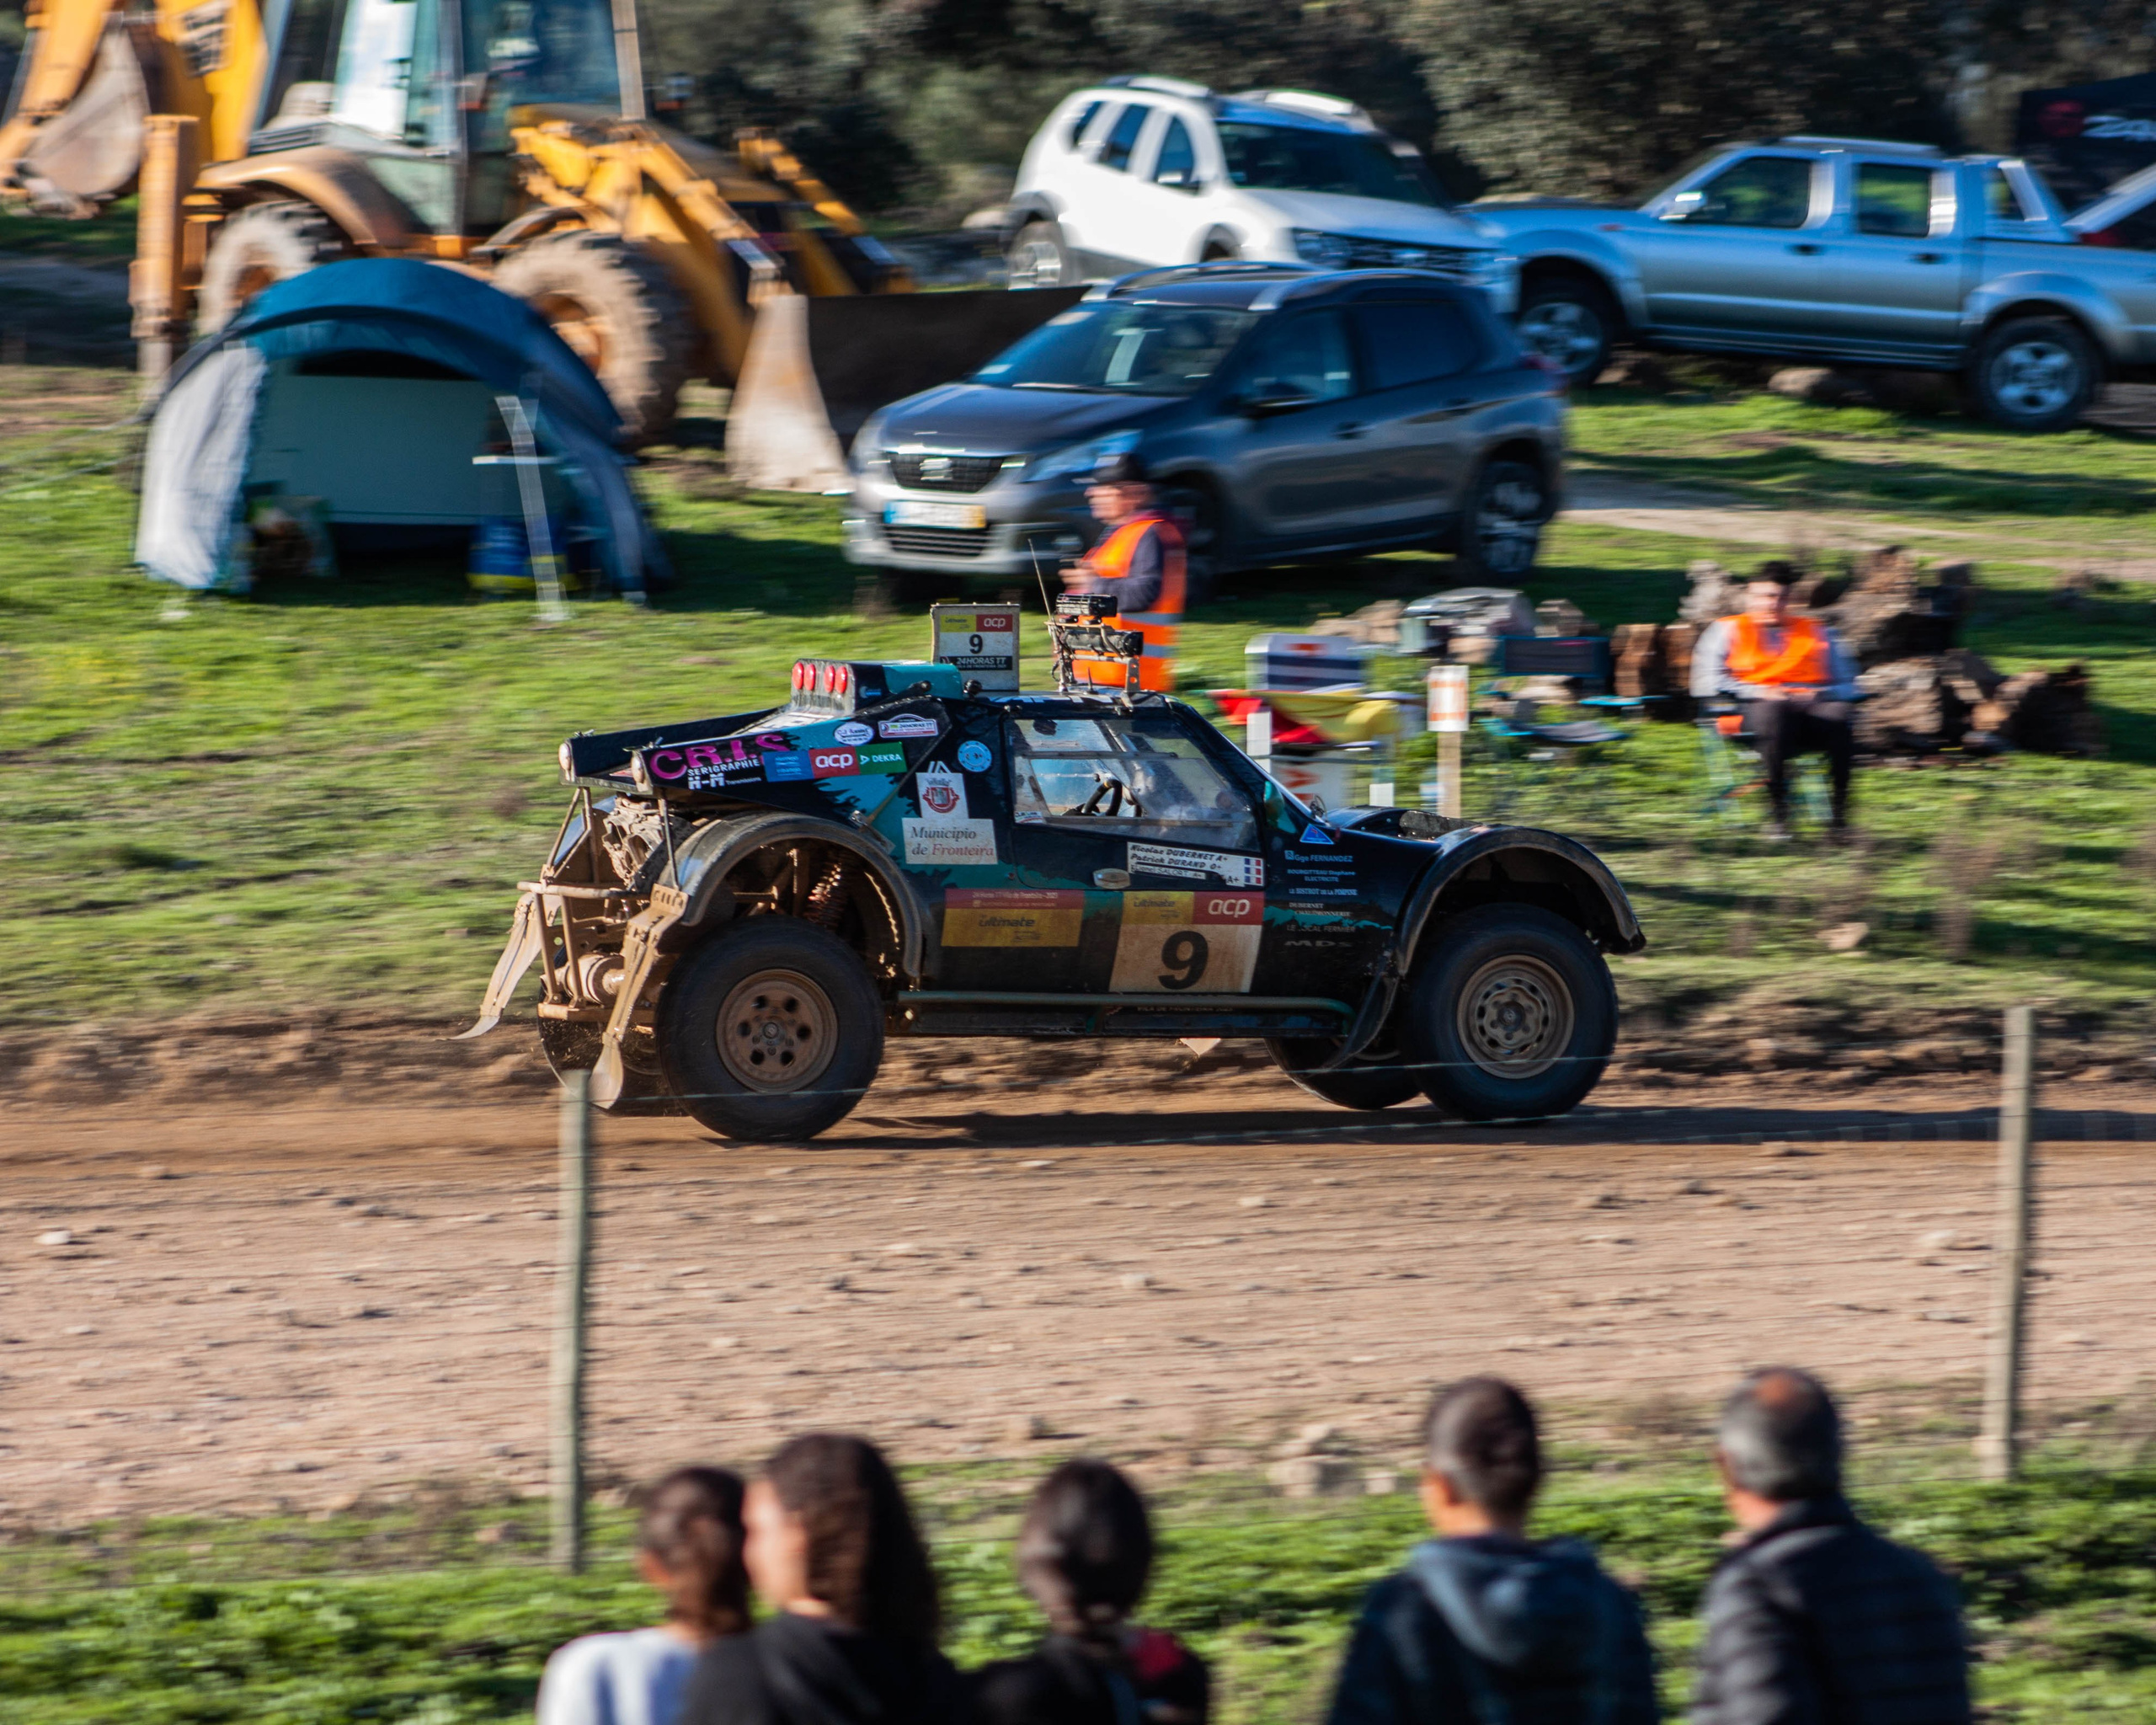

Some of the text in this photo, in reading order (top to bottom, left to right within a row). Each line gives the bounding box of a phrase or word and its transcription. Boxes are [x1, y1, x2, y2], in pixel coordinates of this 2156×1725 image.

[984, 617, 1006, 628] acp
[969, 633, 984, 654] 9
[815, 752, 854, 768] acp
[872, 753, 902, 762] DEKRA
[687, 759, 760, 777] SERIGRAPHIE
[911, 843, 994, 856] de Fronteira
[1130, 844, 1165, 855] Nicolas
[1166, 849, 1214, 861] DUBERNET
[1130, 853, 1165, 864] Patrick
[1167, 857, 1206, 868] DURAND
[1310, 854, 1353, 862] FERNANDEZ
[1208, 899, 1251, 918] acp
[1158, 930, 1209, 991] 9
